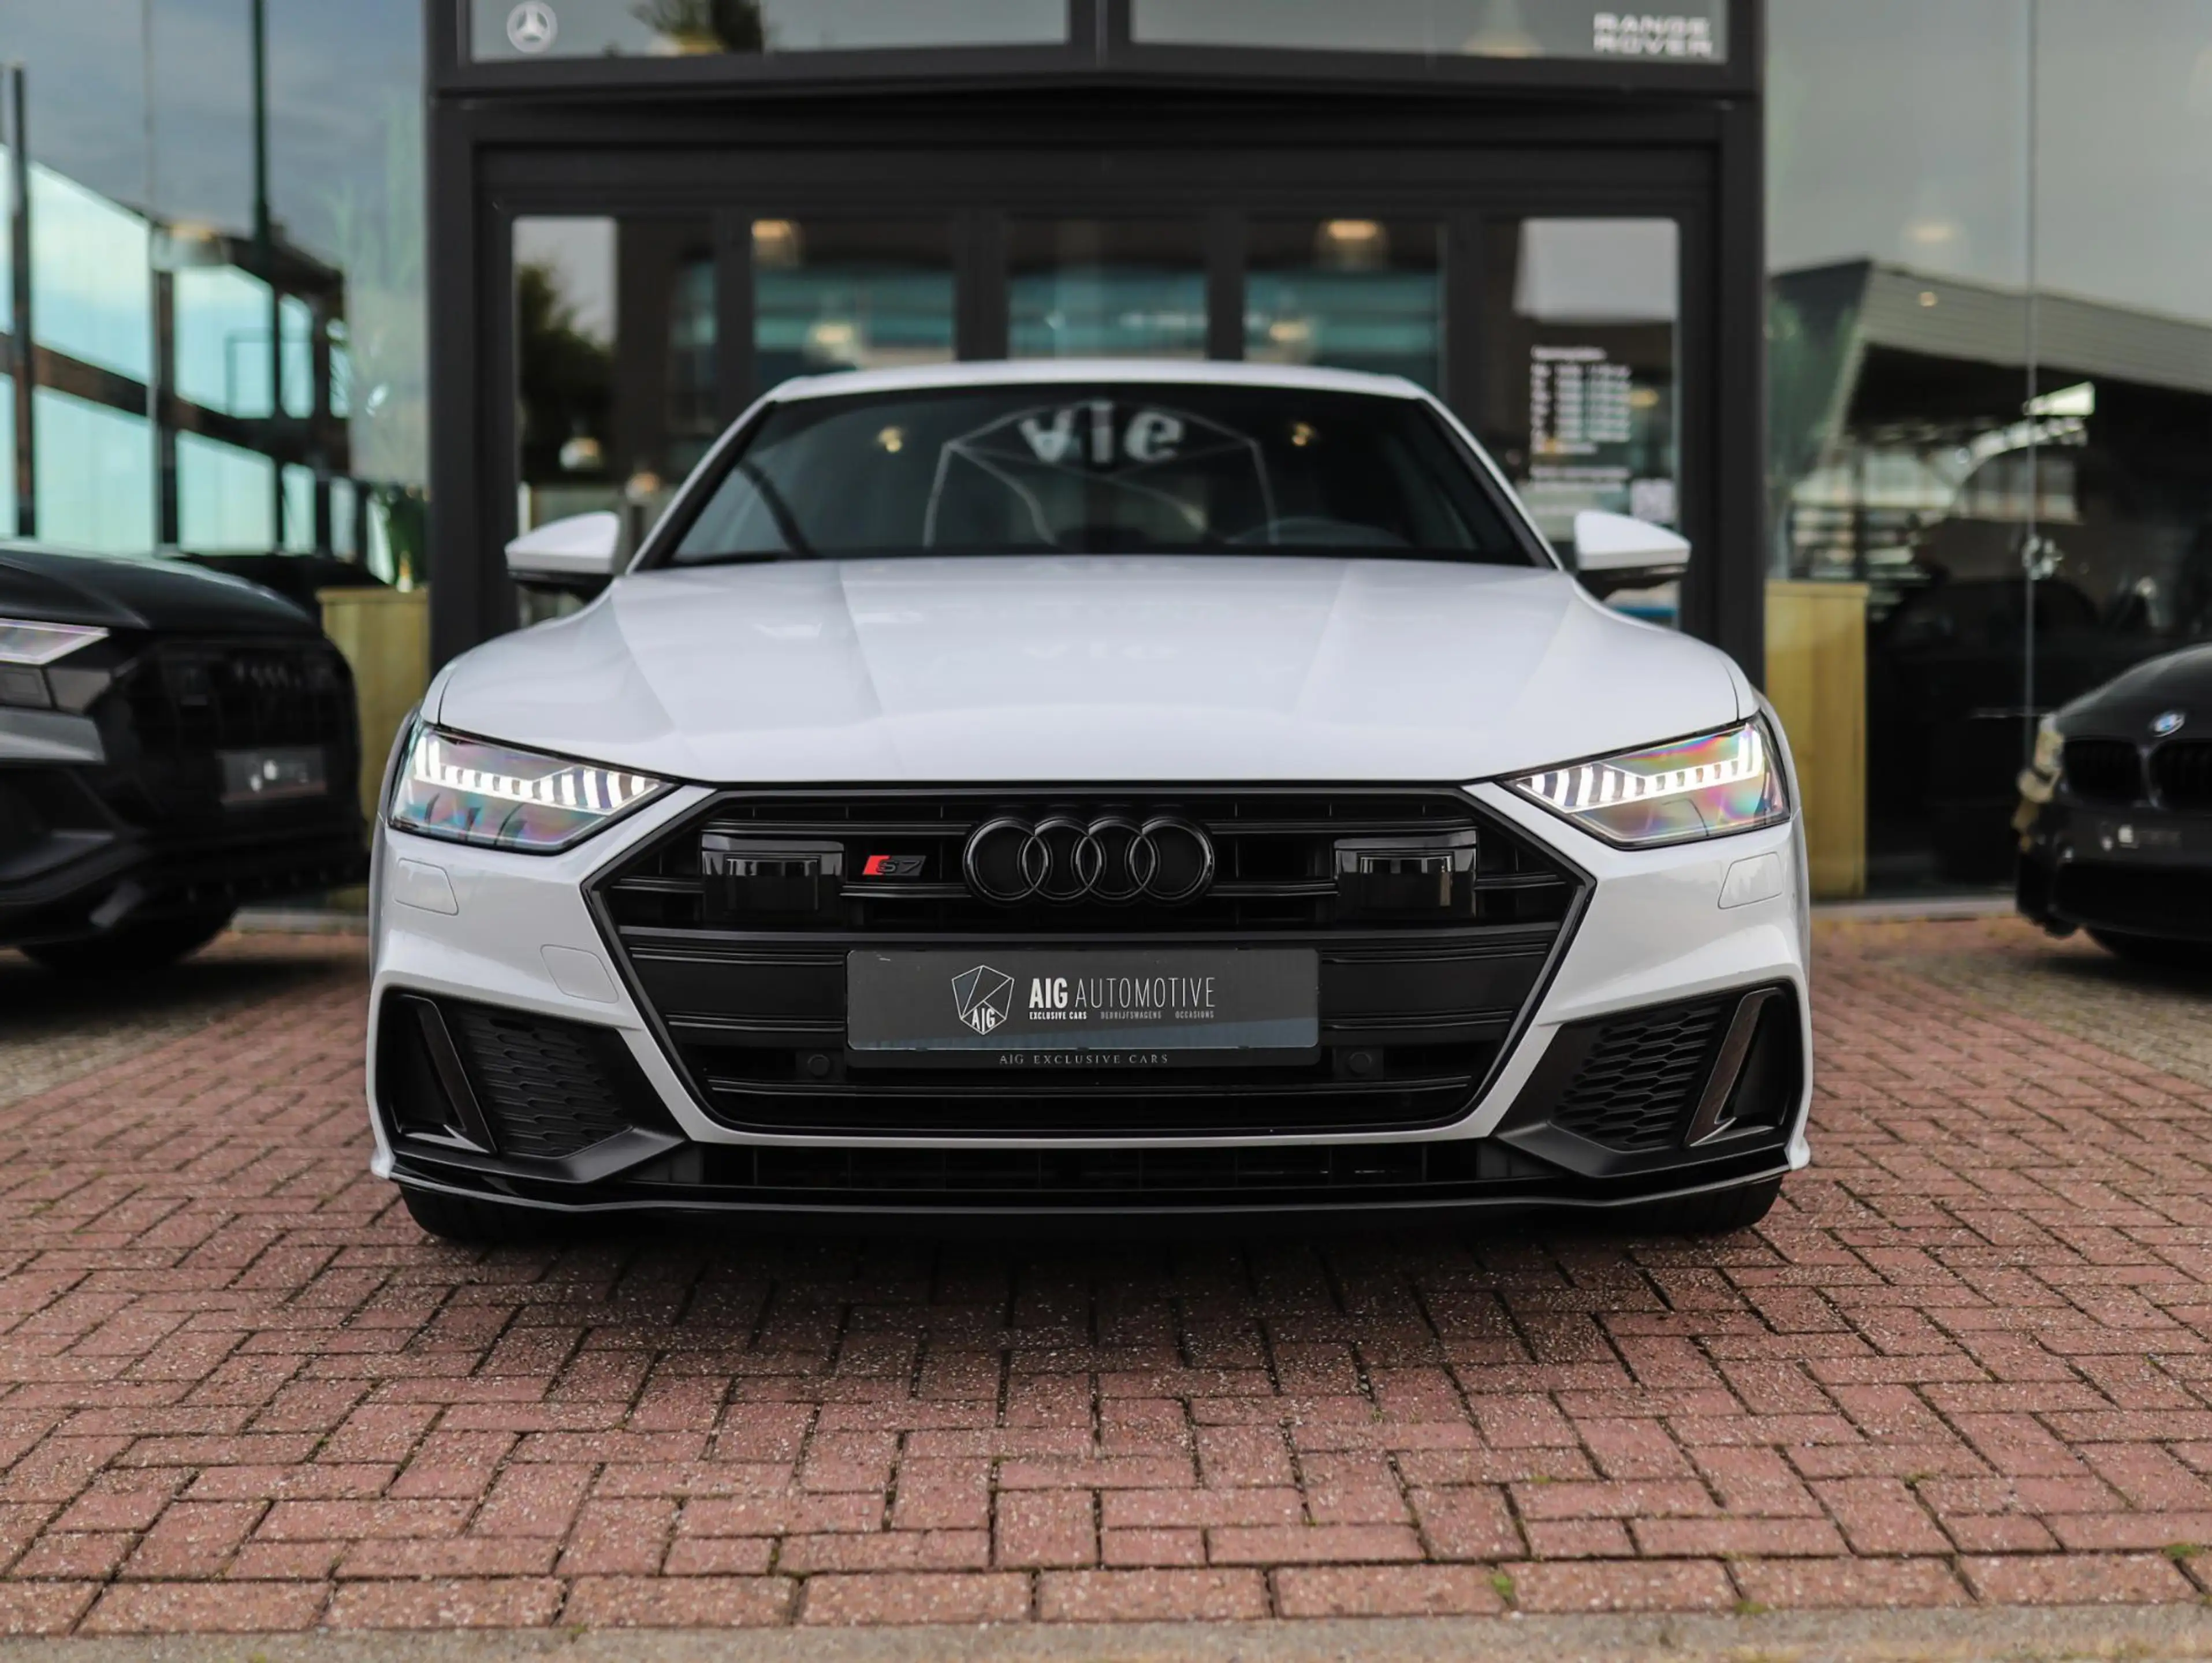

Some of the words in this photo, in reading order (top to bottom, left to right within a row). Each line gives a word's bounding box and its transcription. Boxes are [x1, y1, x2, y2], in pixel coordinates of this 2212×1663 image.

[1593, 13, 1710, 36] RANGE
[1593, 33, 1712, 57] ROVER
[876, 858, 924, 875] S7
[1029, 978, 1068, 1008] AIG
[1075, 978, 1215, 1008] AUTOMOTIVE
[971, 1007, 996, 1033] AIG
[1029, 1012, 1066, 1020] EXCLUSIVE
[1069, 1012, 1087, 1020] CARS
[1100, 1012, 1162, 1020] BEDRIJFSWAGENS
[1175, 1011, 1214, 1019] OCCASIONS
[999, 1054, 1024, 1064] AIG
[1034, 1054, 1120, 1064] EXCLUSIVE
[1129, 1054, 1168, 1064] CARS
